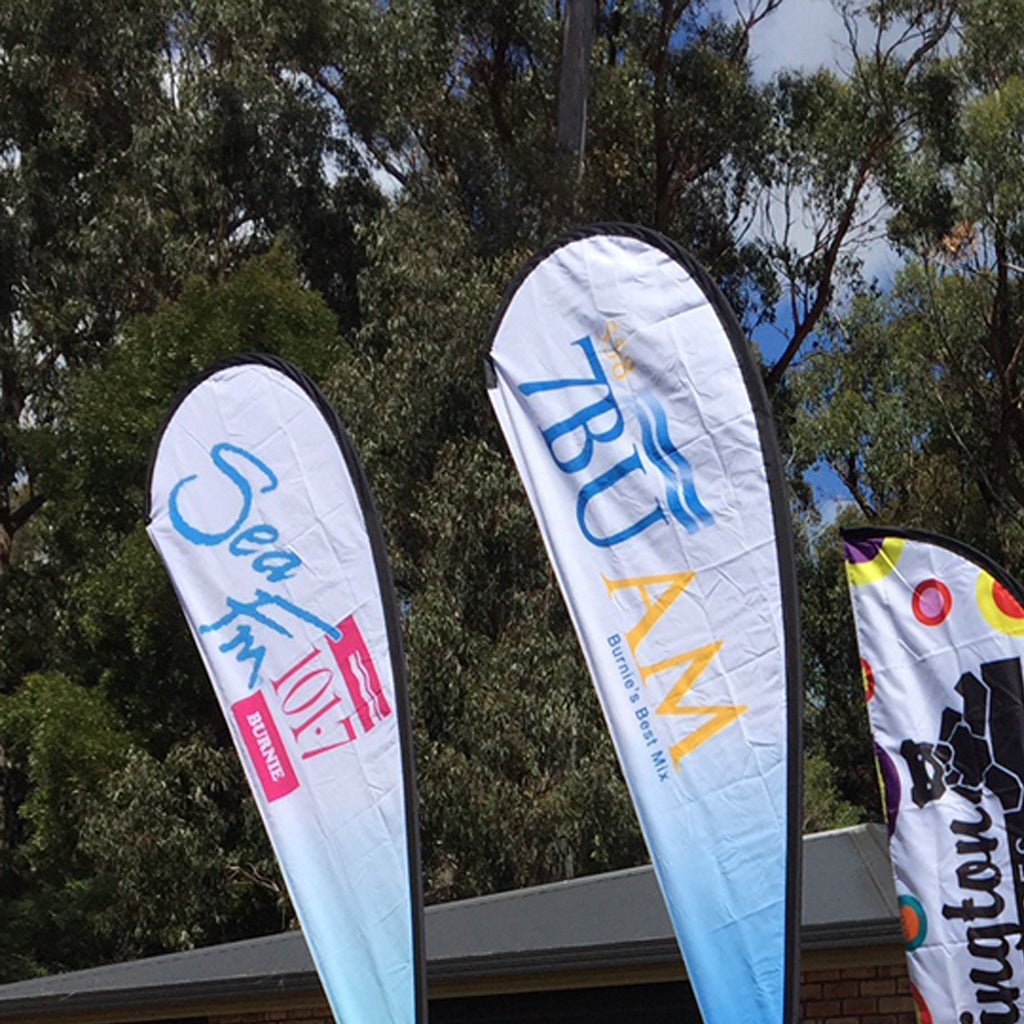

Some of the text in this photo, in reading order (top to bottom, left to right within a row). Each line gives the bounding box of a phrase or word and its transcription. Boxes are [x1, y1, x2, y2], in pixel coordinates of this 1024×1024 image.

[168, 442, 302, 582] Sea
[519, 335, 748, 774] 7BU AM
[246, 711, 285, 783] BURNIE
[607, 633, 671, 782] Burnie's Best Mix
